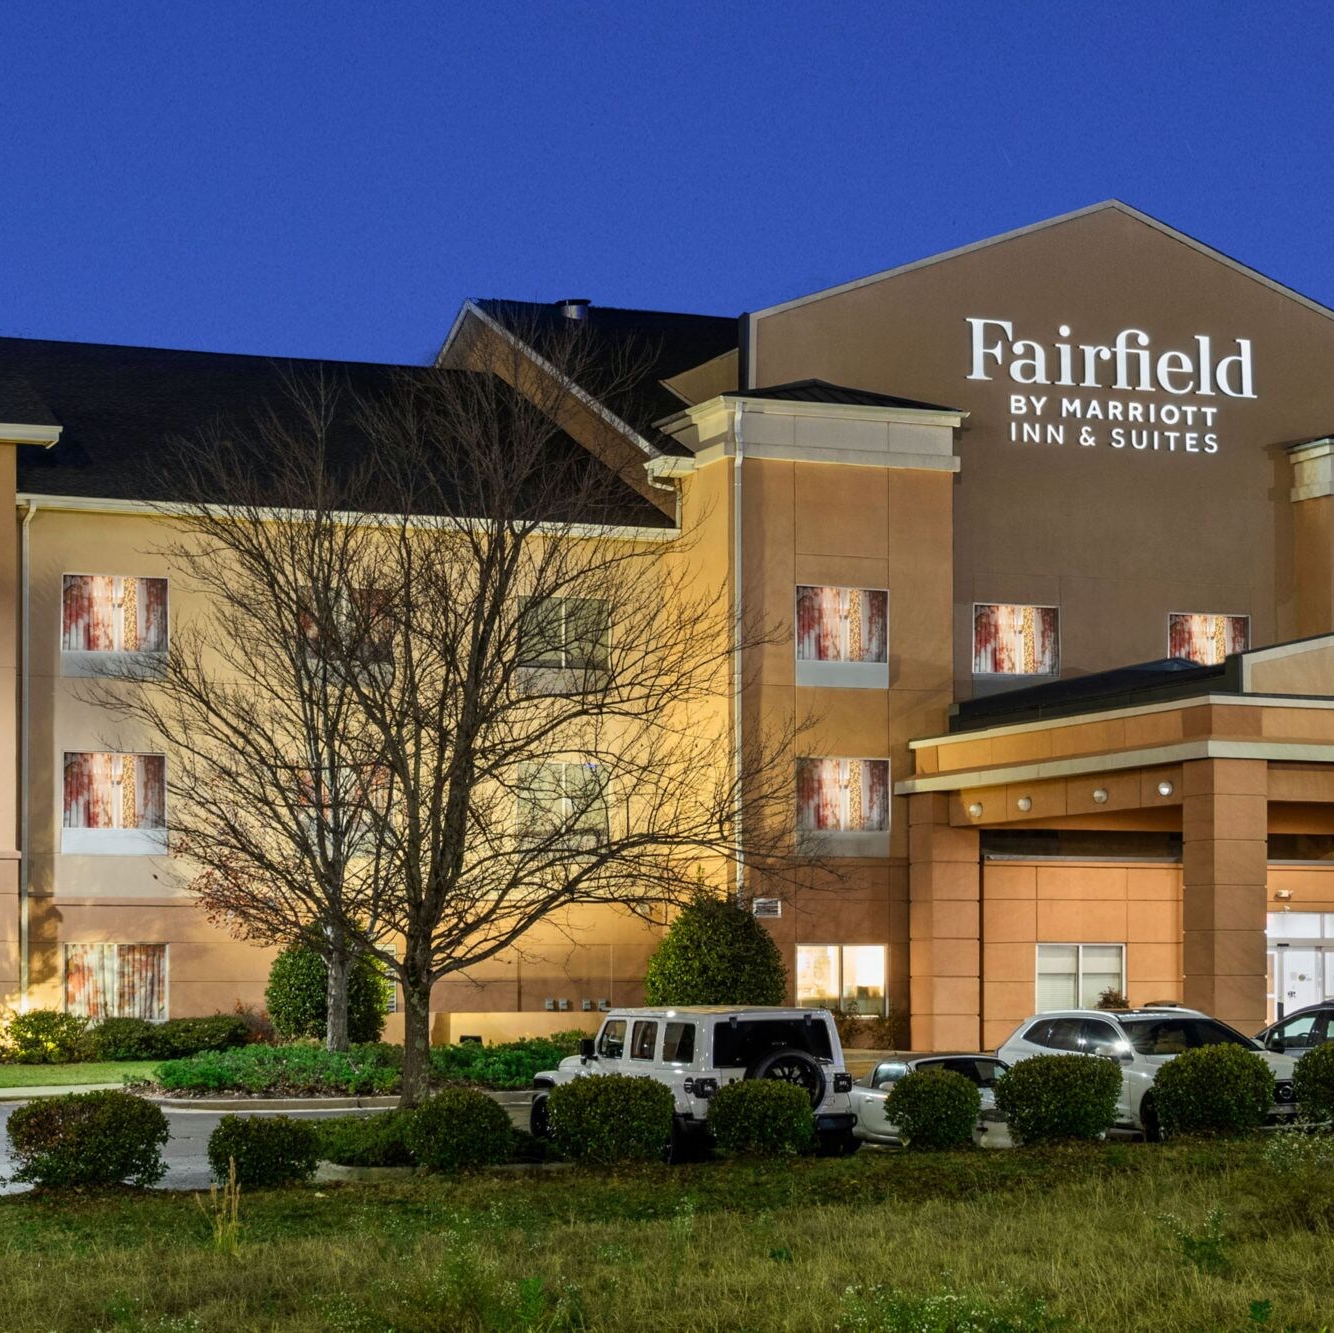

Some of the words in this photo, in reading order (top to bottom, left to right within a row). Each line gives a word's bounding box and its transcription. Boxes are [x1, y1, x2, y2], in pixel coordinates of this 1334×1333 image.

[965, 317, 1258, 399] Fairfield
[1010, 394, 1048, 416] BY
[1061, 397, 1218, 427] MARRIOTT
[1010, 421, 1065, 445] INN
[1079, 425, 1096, 447] &
[1111, 427, 1219, 454] SUITES
